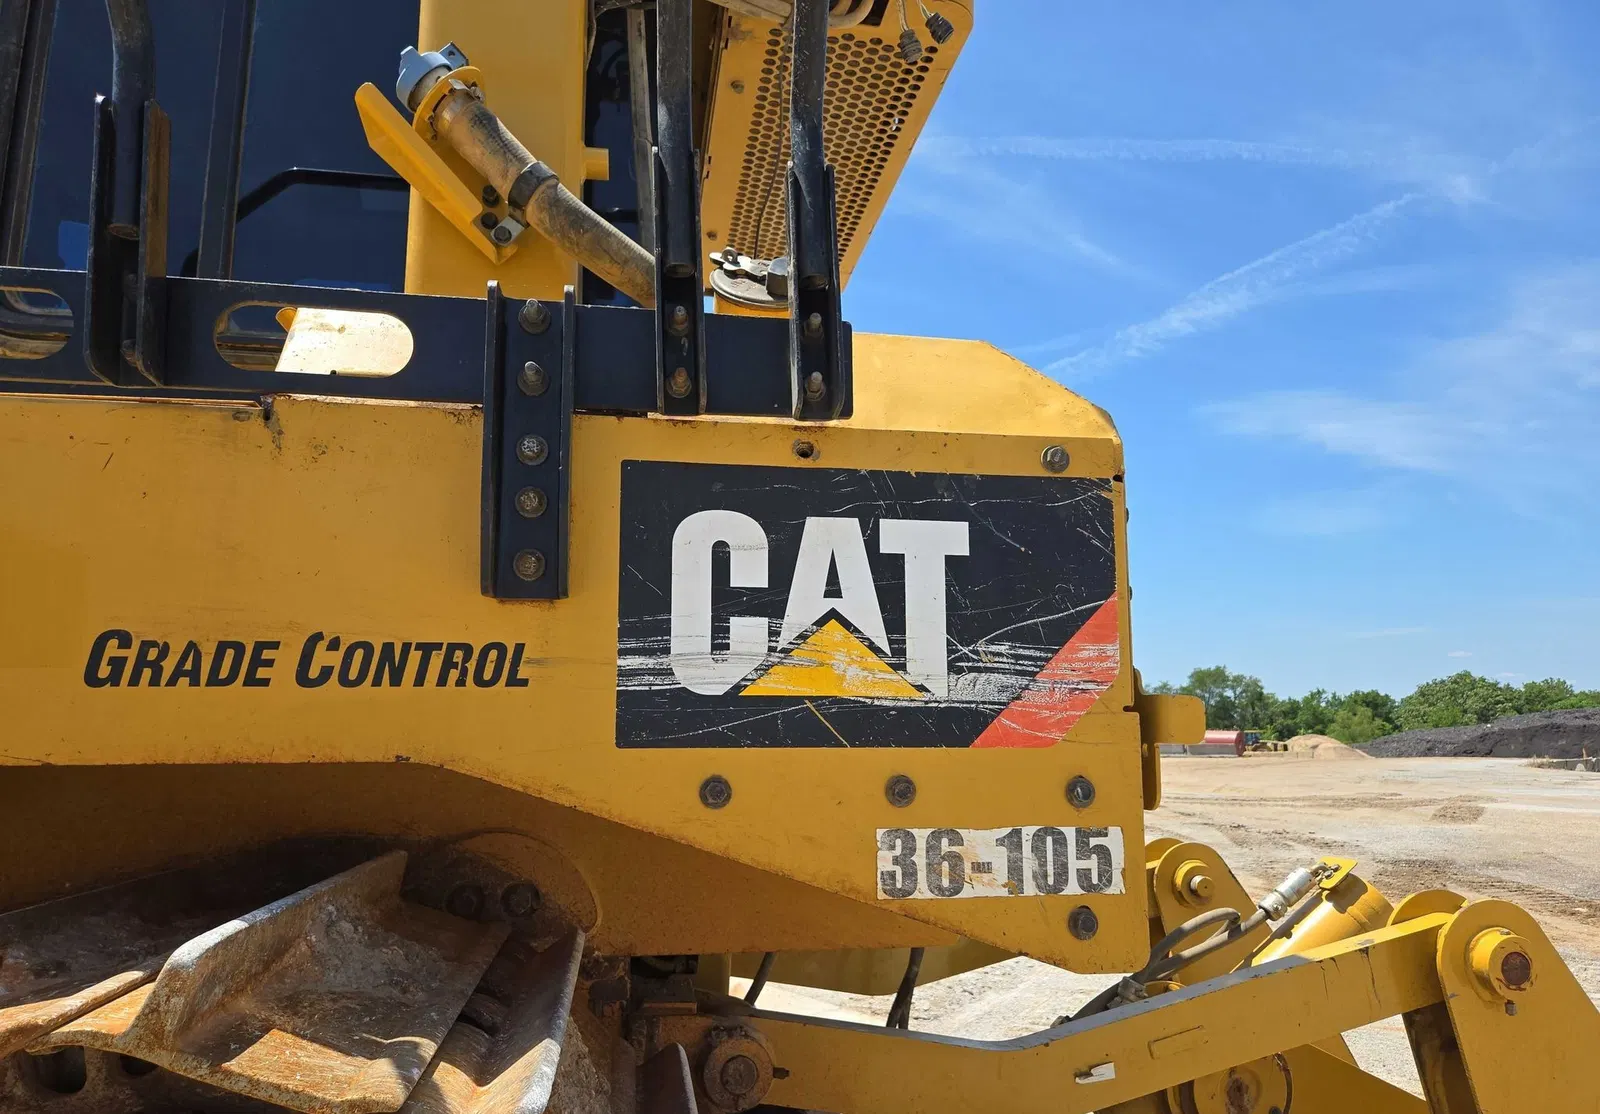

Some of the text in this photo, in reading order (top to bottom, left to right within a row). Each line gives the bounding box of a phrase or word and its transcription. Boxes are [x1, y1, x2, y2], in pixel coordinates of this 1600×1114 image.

[671, 509, 970, 697] CAT
[84, 629, 529, 688] GRADE CONTROL
[879, 826, 1114, 899] 36-105
